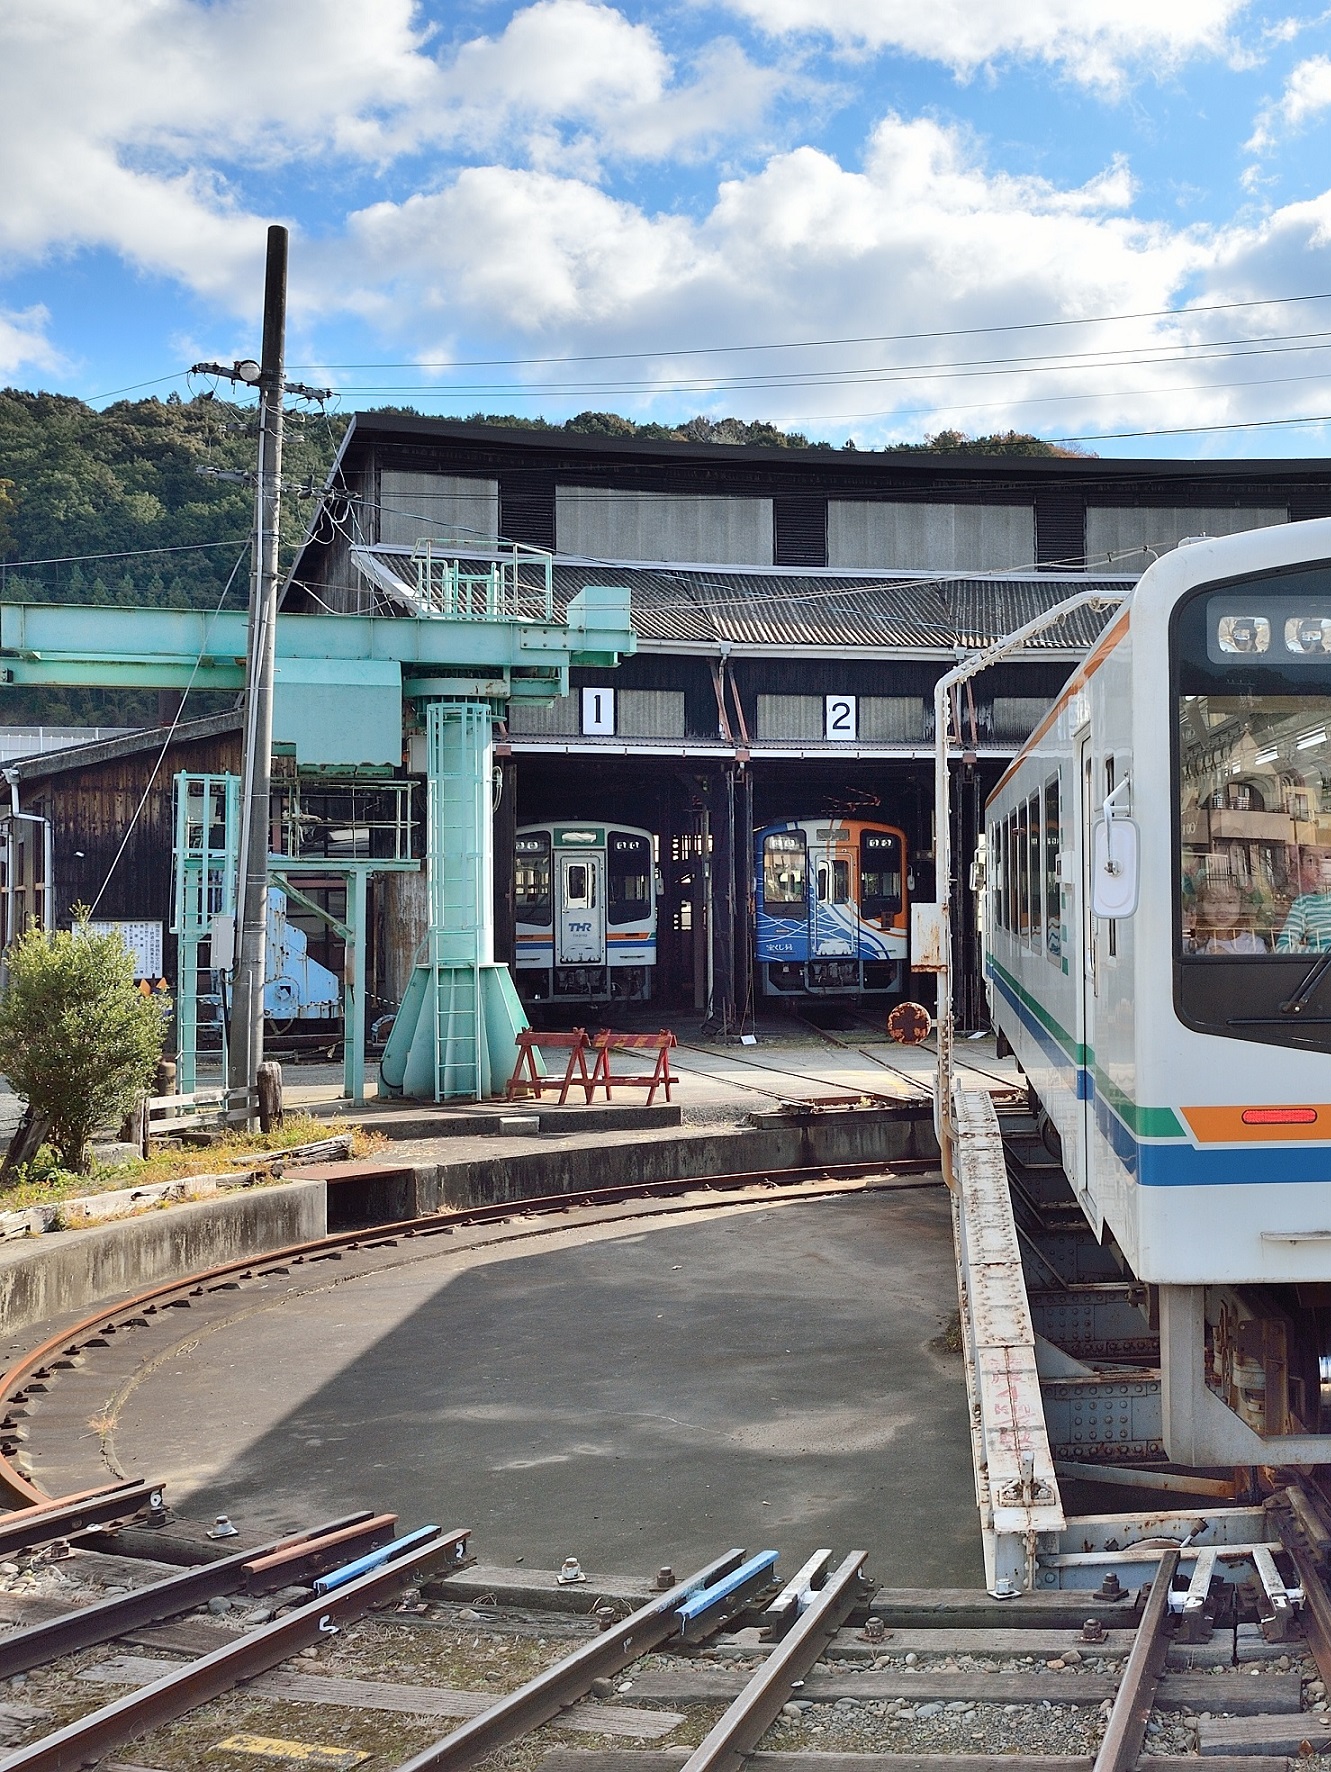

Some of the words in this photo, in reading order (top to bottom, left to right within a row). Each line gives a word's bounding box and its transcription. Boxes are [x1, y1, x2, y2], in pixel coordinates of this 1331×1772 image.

[593, 694, 602, 724] 1
[831, 702, 851, 730] 2
[568, 922, 592, 932] THR
[150, 1490, 162, 1507] 6
